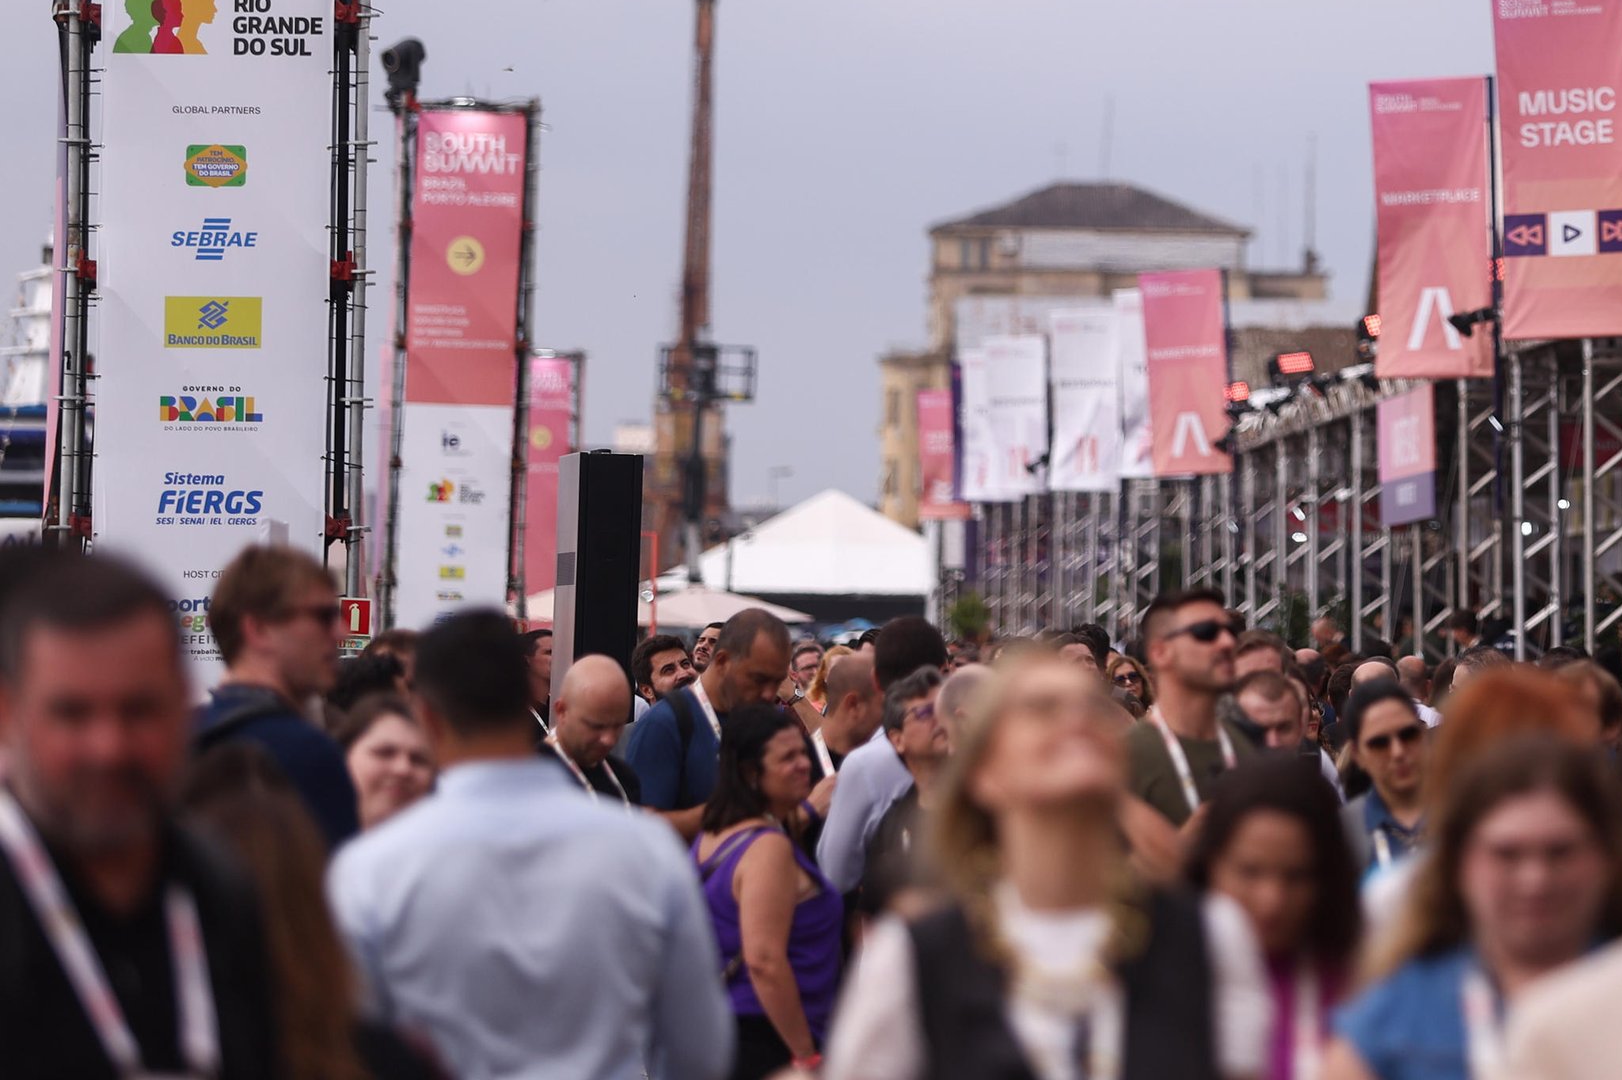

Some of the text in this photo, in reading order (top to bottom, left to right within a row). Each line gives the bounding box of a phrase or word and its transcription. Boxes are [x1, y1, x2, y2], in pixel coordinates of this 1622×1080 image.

[232, 16, 323, 35] GRANDE
[233, 37, 312, 57] DO SUL
[172, 105, 261, 115] GLOBAL PARTNERS
[1518, 86, 1616, 117] MUSIC
[1520, 119, 1615, 148] STAGE
[424, 132, 506, 154] SOUTH
[171, 231, 258, 247] SEBRAE
[168, 333, 257, 346] BANCO DO BRASIL
[160, 396, 263, 422] BRASIL
[164, 472, 225, 485] Sistema
[155, 517, 257, 526] SESI SENAI IEL CIERGS
[183, 570, 210, 579] HOST
